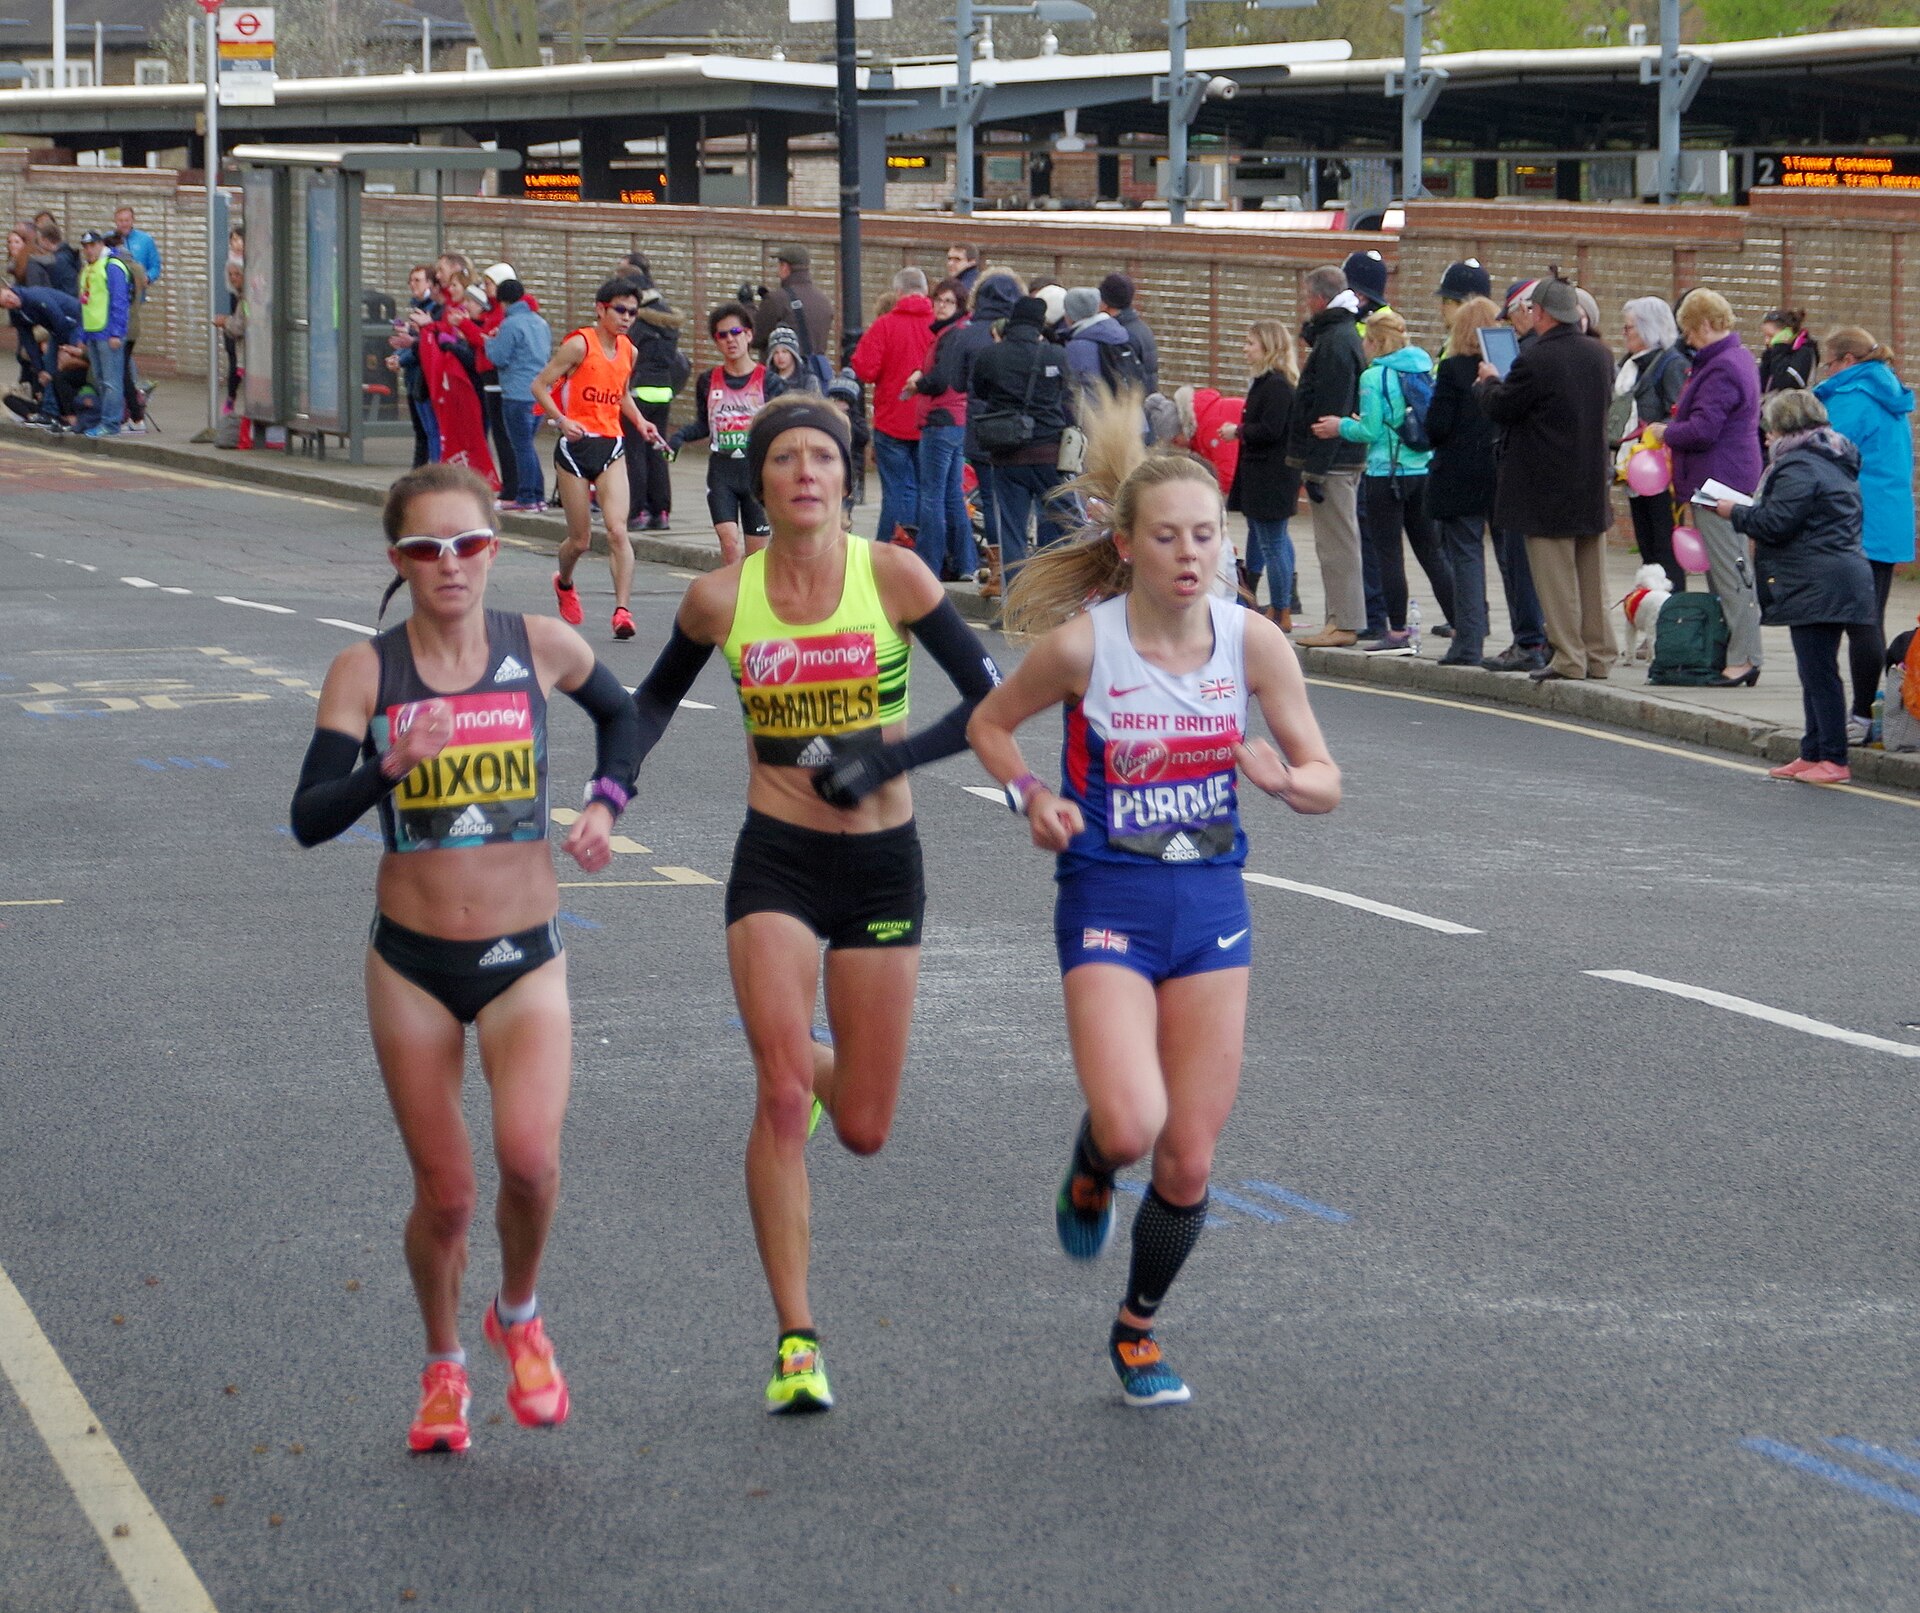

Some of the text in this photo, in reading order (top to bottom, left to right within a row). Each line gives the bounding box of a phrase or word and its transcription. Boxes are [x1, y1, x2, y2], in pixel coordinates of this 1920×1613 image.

[1758, 157, 1775, 185] 2
[748, 639, 871, 682] Virgin money
[494, 667, 529, 683] adidas
[456, 708, 526, 729] money
[751, 685, 874, 729] SAMUELS
[1111, 712, 1237, 732] GREAT BRITAIN
[1115, 739, 1161, 778] Virgin
[402, 747, 531, 800] DIXON
[1113, 774, 1230, 829] PURDUE
[450, 822, 493, 837] adidas
[1162, 849, 1201, 862] adidas
[479, 950, 522, 966] adidas
